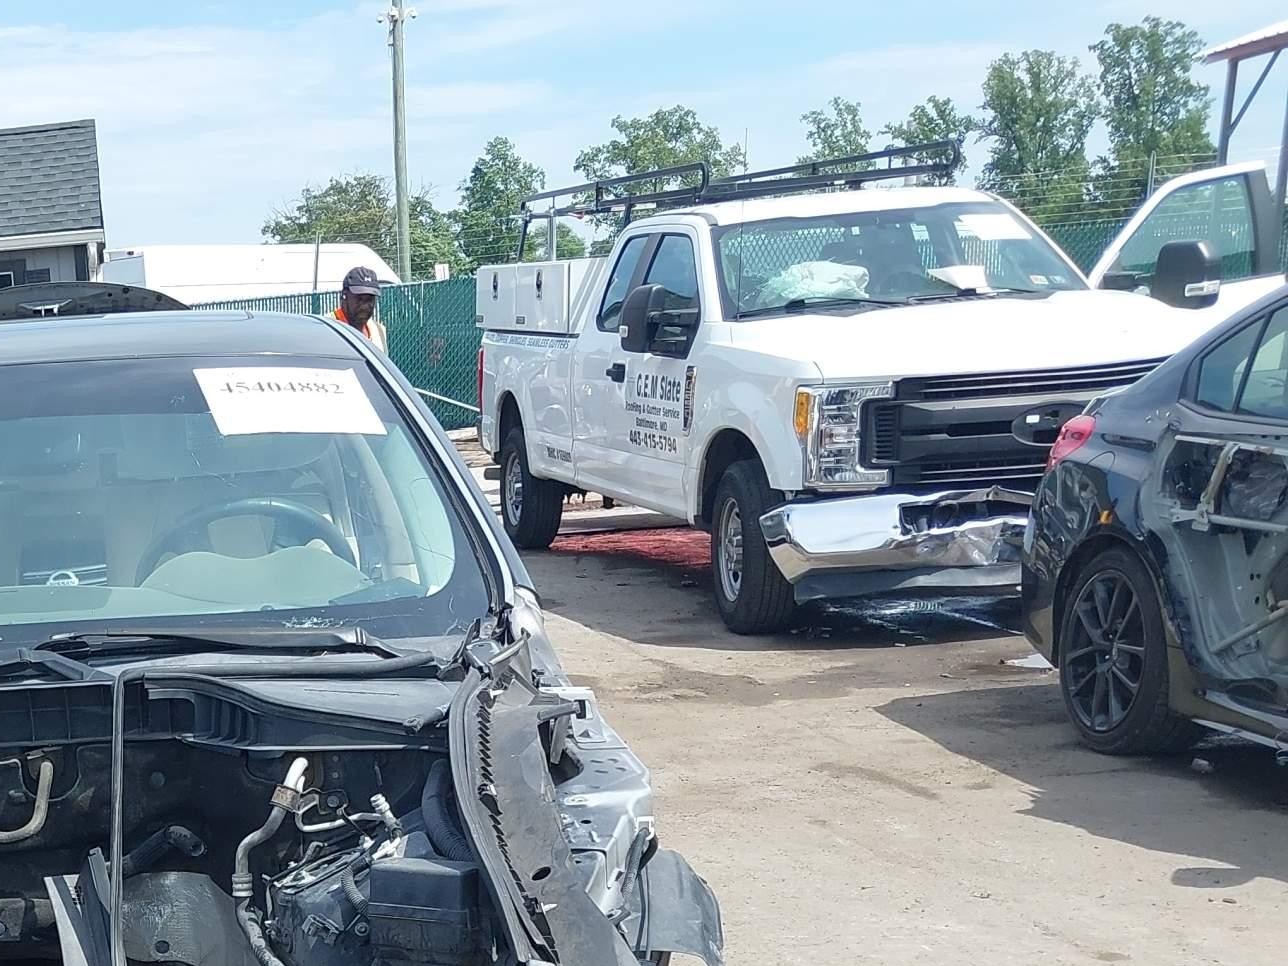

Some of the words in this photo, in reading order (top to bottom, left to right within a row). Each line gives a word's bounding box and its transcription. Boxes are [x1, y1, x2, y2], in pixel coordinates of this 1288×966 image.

[220, 381, 344, 394] 45404882
[659, 375, 681, 402] Slate
[662, 407, 680, 420] Service
[629, 429, 677, 454] 443-415-5794
